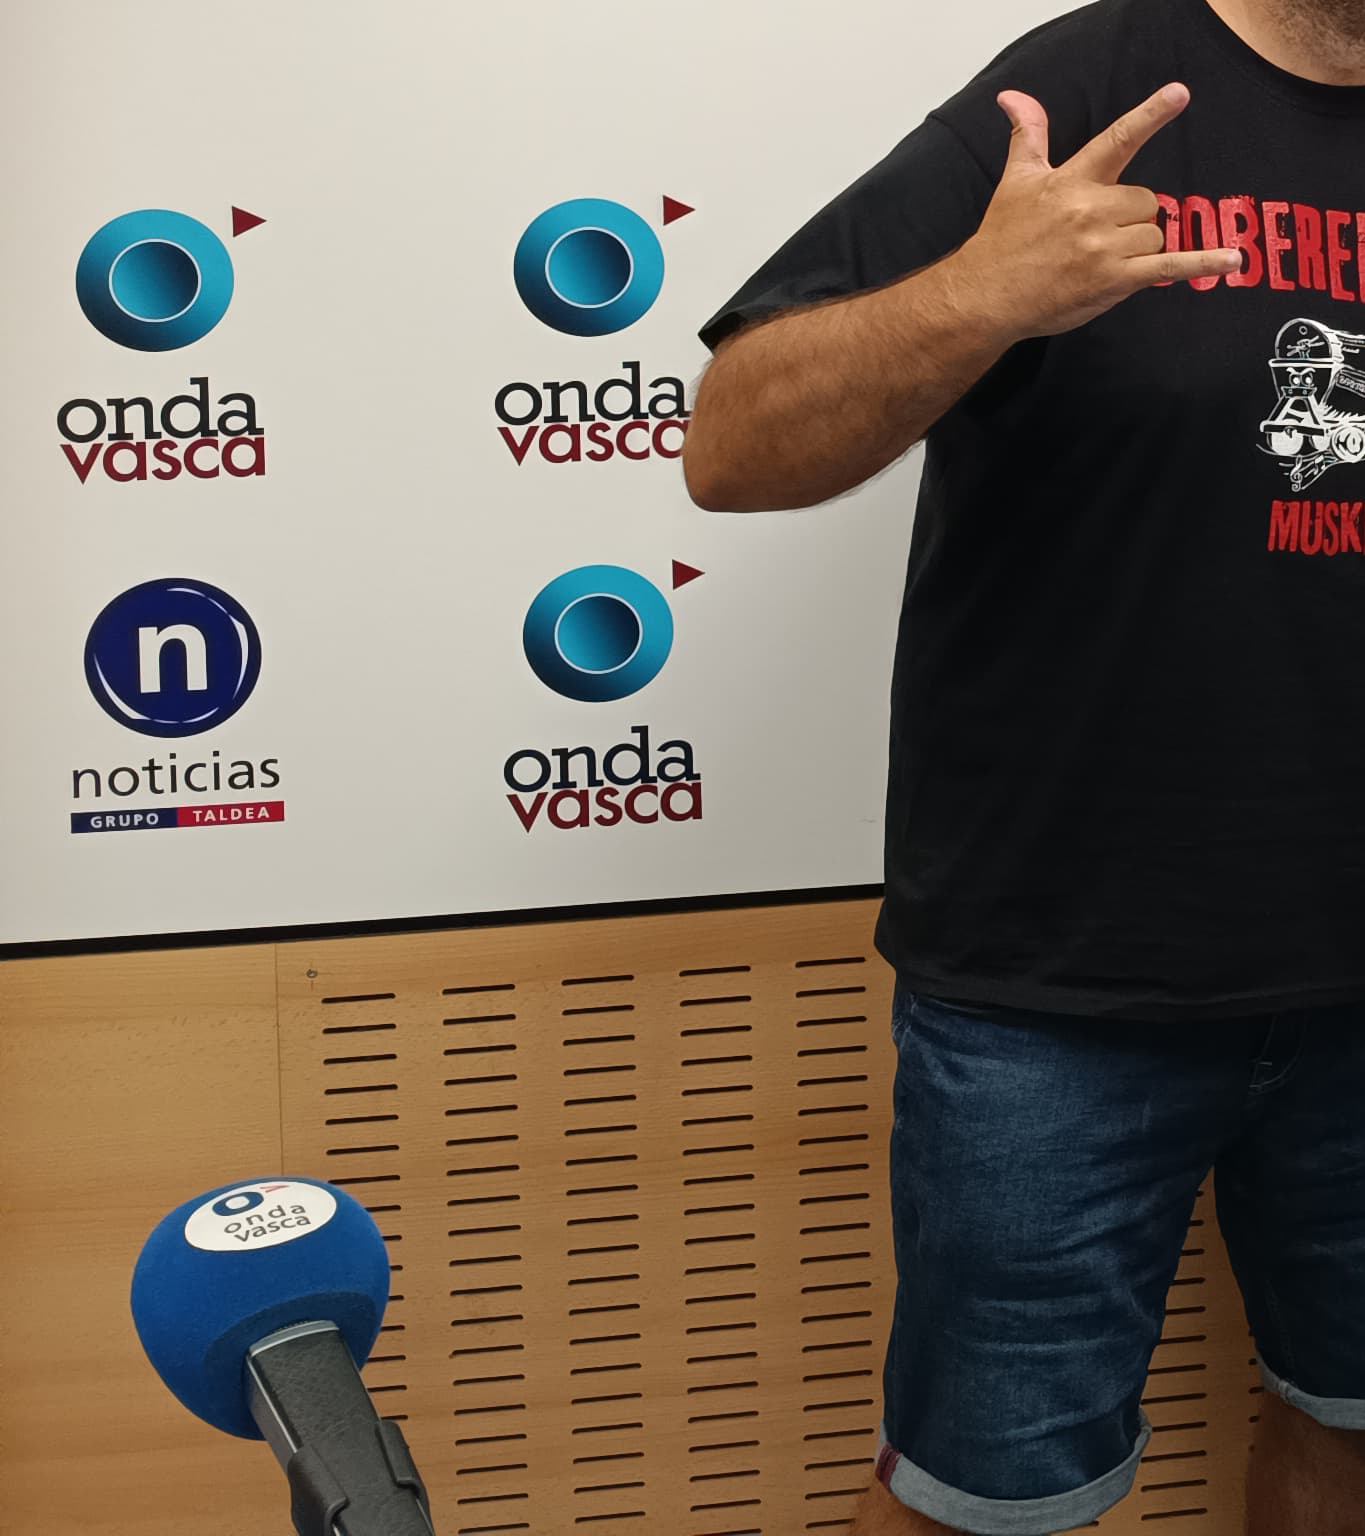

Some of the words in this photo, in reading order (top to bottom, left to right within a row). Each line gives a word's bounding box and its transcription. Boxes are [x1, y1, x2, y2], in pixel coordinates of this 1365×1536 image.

[57, 377, 264, 443] onda
[495, 361, 692, 425] onda
[60, 435, 266, 485] vasca
[137, 622, 208, 694] n
[72, 750, 280, 798] noticias
[504, 725, 700, 792] onda
[90, 812, 160, 829] GRUPO
[192, 805, 271, 823] TALDEA
[506, 782, 702, 833] vasca
[224, 1205, 306, 1234] onda
[234, 1215, 311, 1242] vasca
